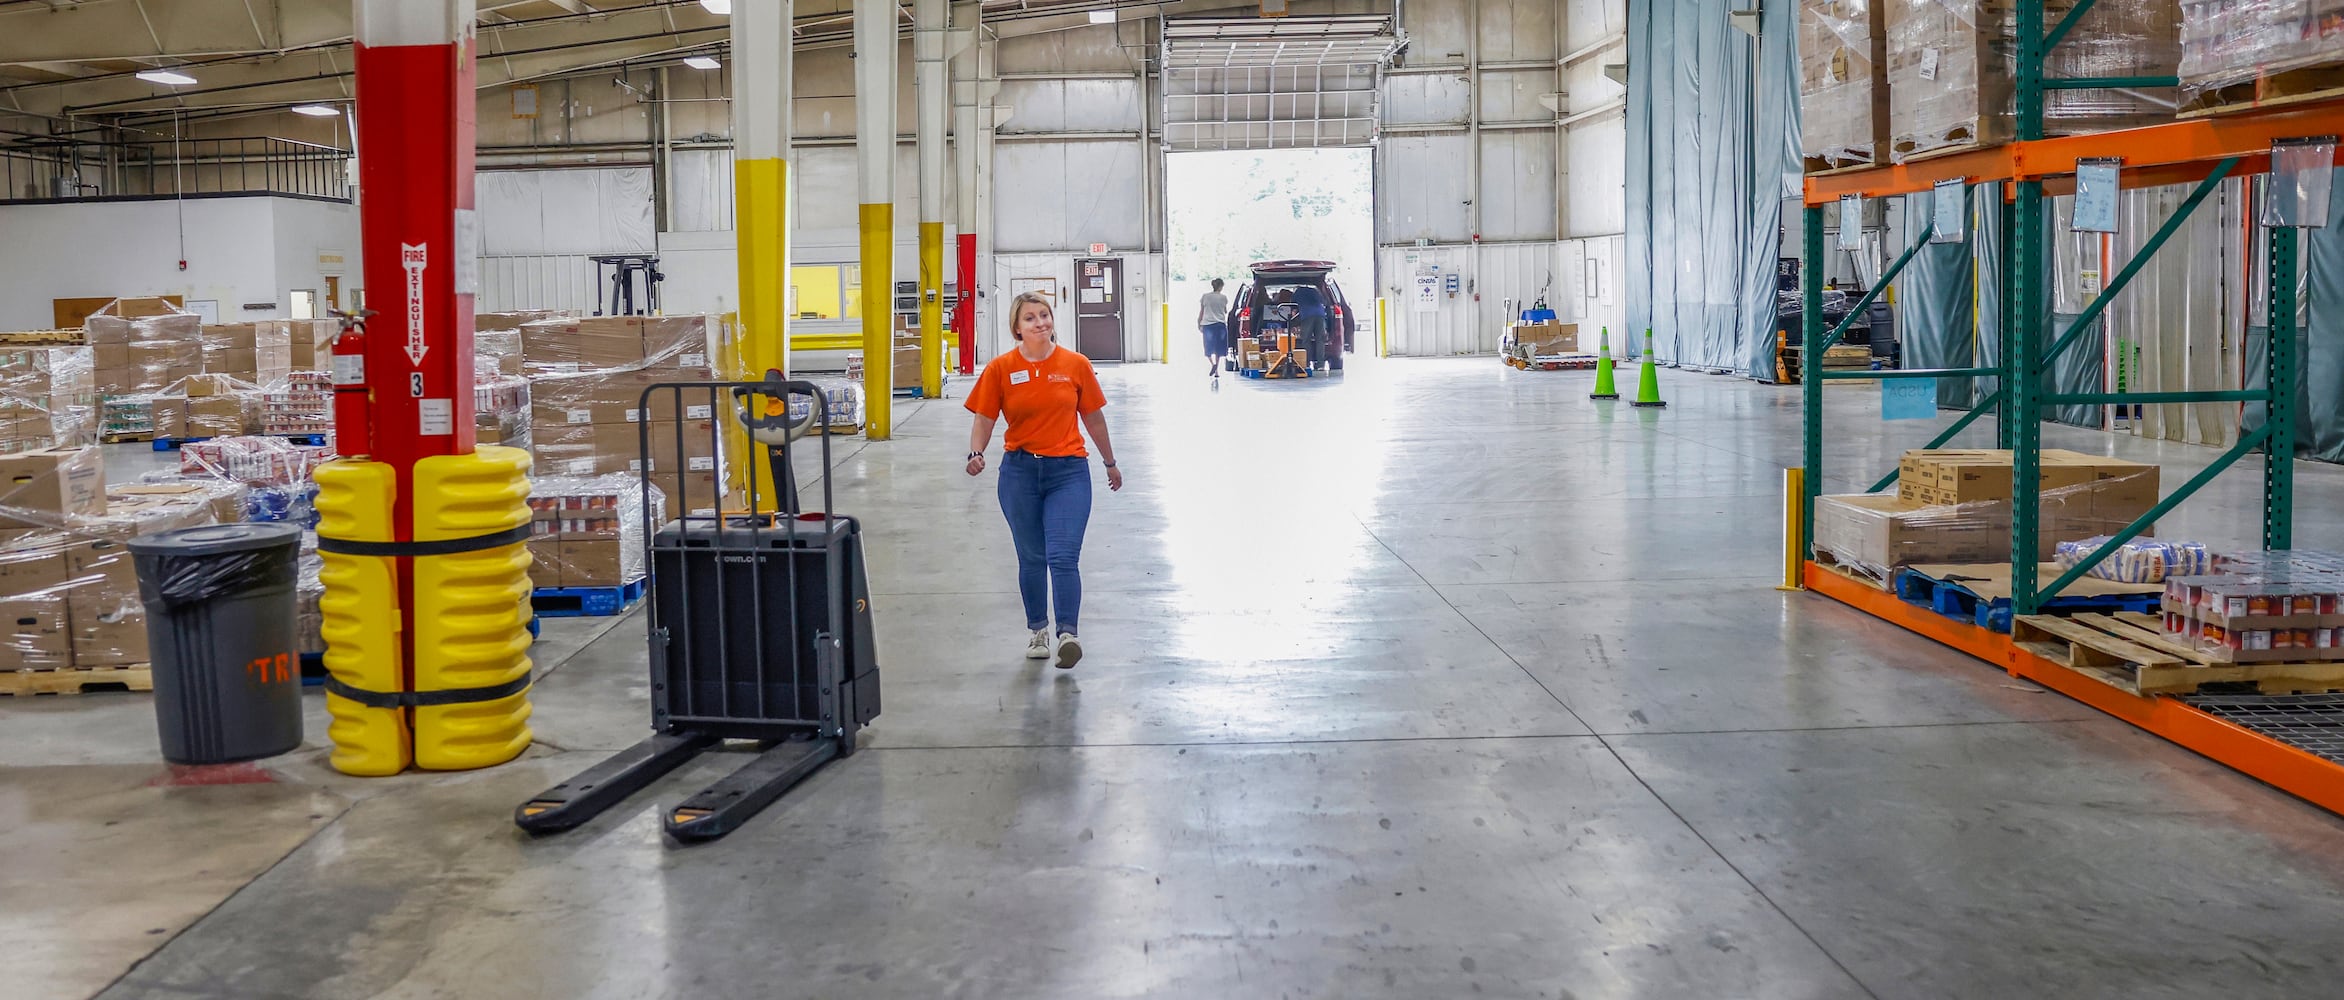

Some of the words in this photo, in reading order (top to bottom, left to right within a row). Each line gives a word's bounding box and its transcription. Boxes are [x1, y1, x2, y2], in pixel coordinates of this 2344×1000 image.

[1093, 244, 1104, 252] EXIT
[404, 250, 424, 262] FIRE
[1085, 266, 1098, 275] EXIT
[411, 266, 421, 359] EXTINGUISHER
[413, 374, 422, 395] 3
[714, 555, 767, 563] cown.cm
